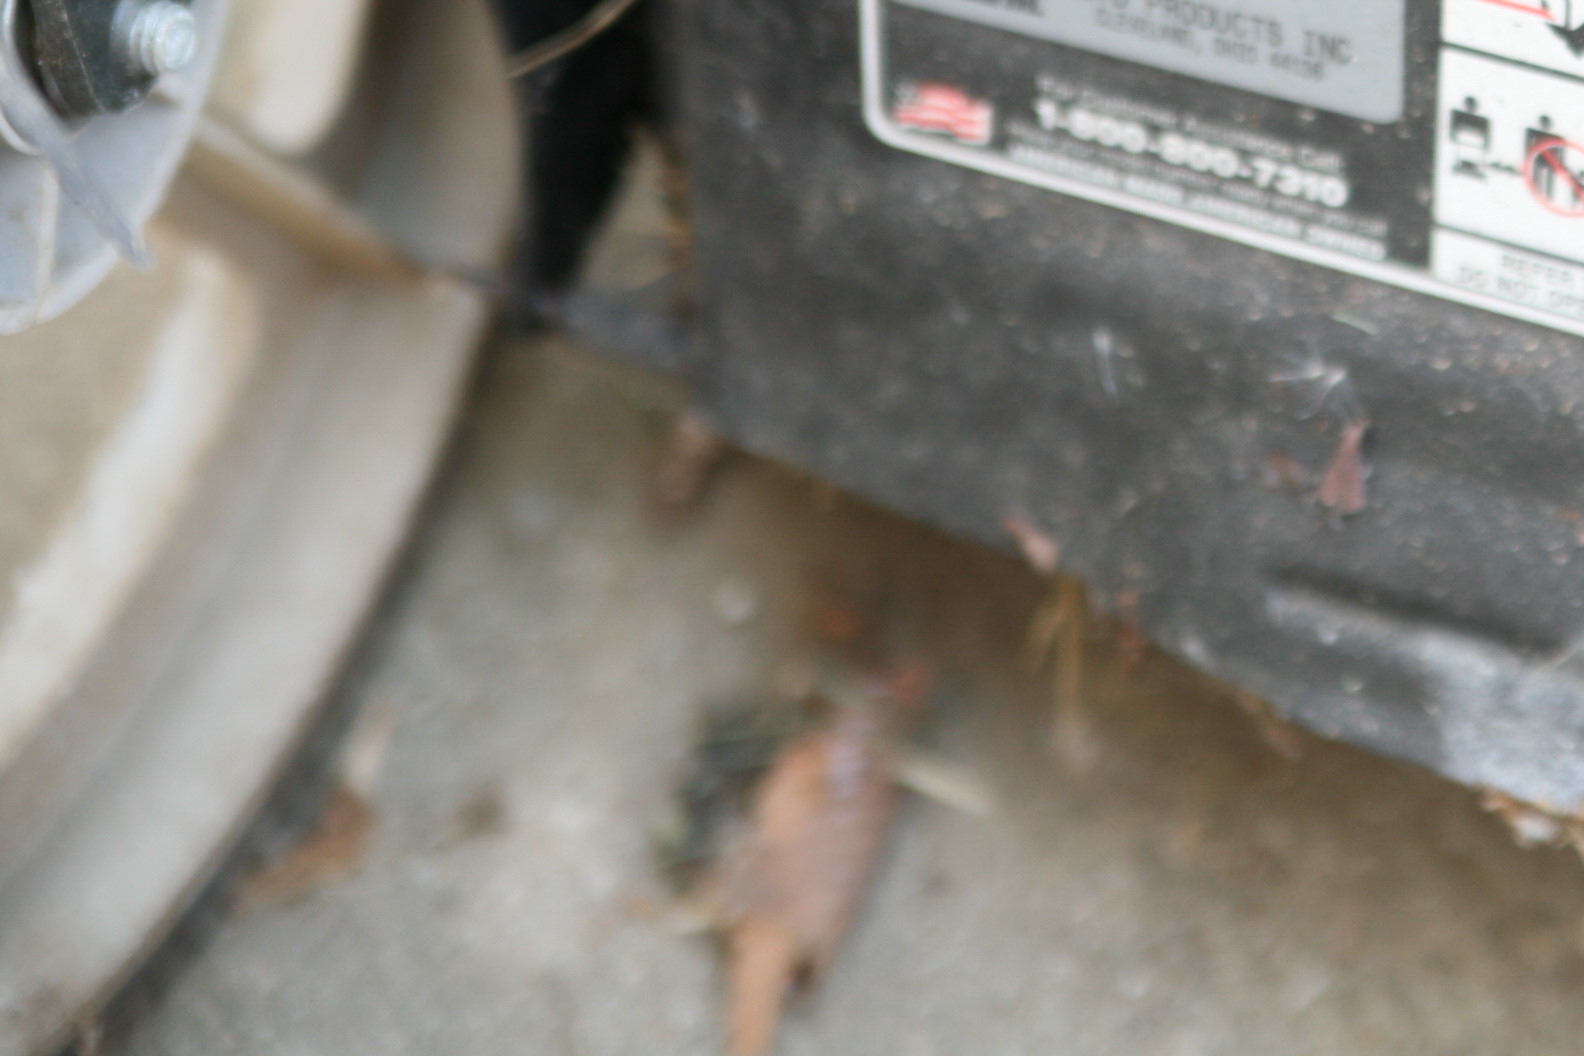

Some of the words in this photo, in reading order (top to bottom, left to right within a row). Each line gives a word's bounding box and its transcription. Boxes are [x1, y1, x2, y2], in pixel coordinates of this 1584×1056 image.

[1456, 264, 1489, 290] DO
[1495, 274, 1538, 303] NOT
[1499, 252, 1573, 288] REFER
